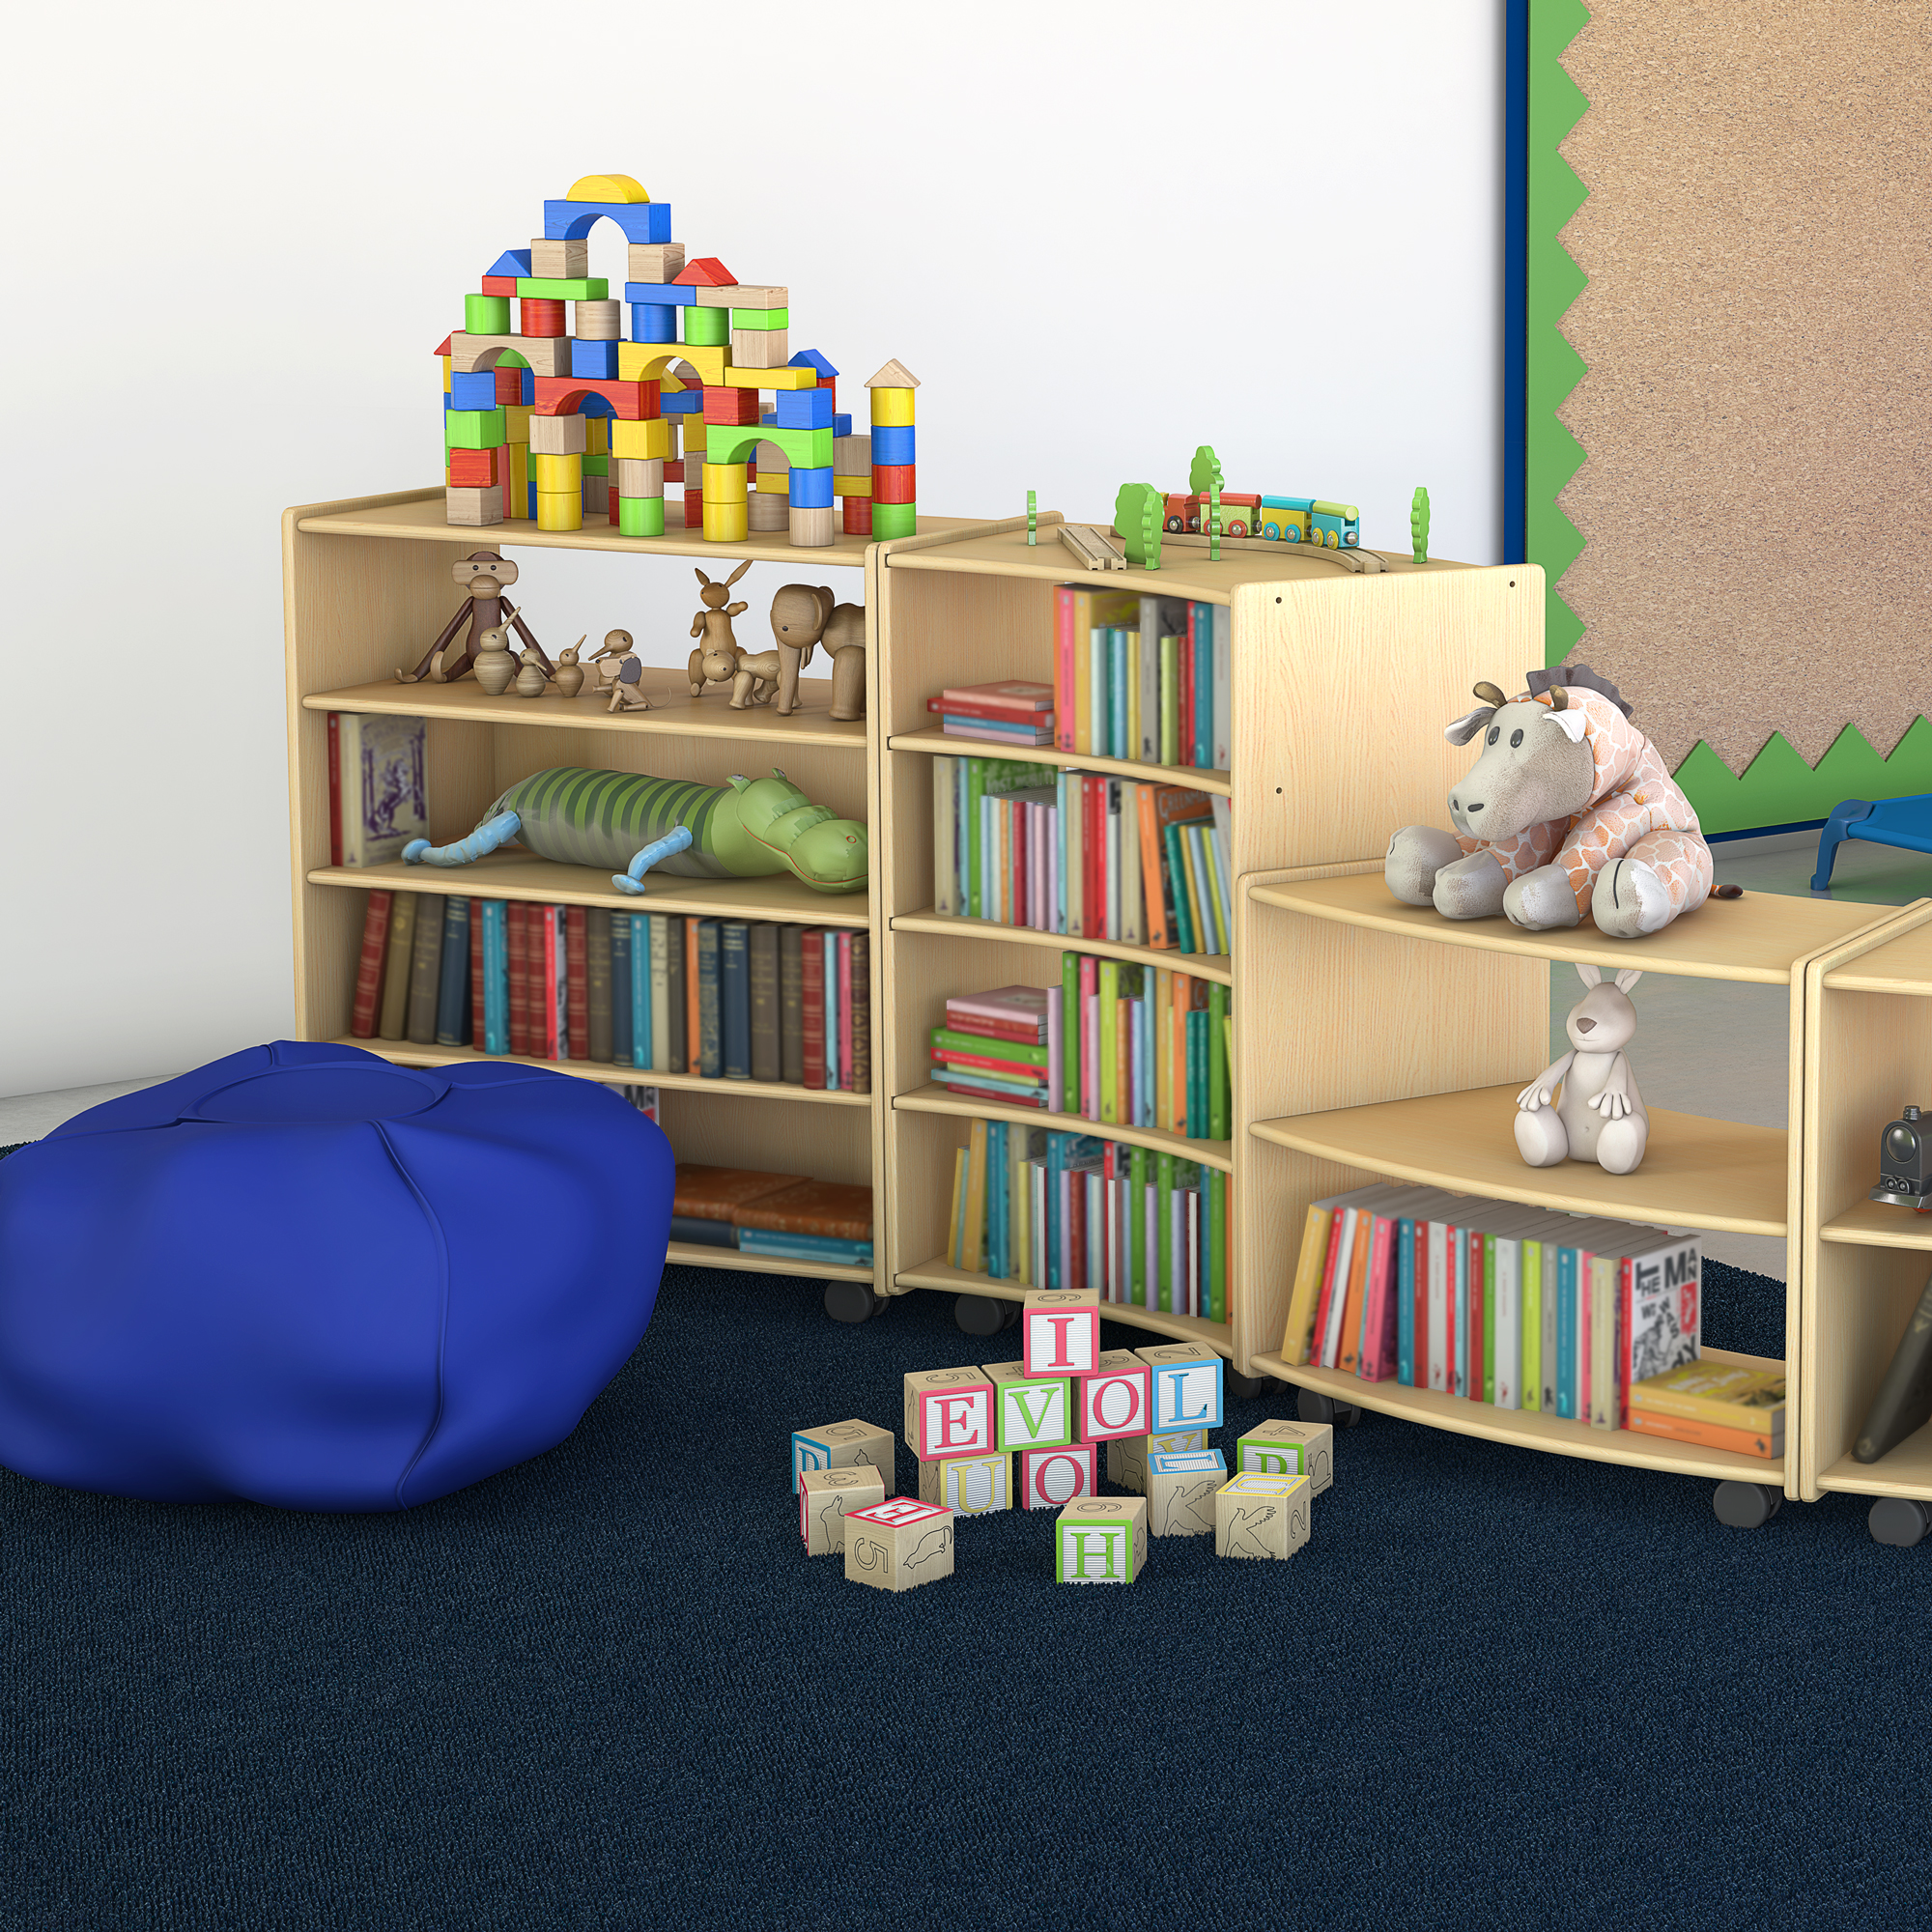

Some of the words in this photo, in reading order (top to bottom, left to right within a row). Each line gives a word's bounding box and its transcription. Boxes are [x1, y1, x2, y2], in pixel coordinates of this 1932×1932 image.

[1047, 1318, 1074, 1367] I
[934, 1396, 978, 1448] E
[1009, 1387, 1060, 1438] V
[1093, 1378, 1139, 1429] O
[1168, 1373, 1207, 1422] L
[952, 1461, 1003, 1513] U
[1036, 1455, 1085, 1504] O
[854, 1537, 888, 1574] 5
[1070, 1533, 1120, 1577] H
